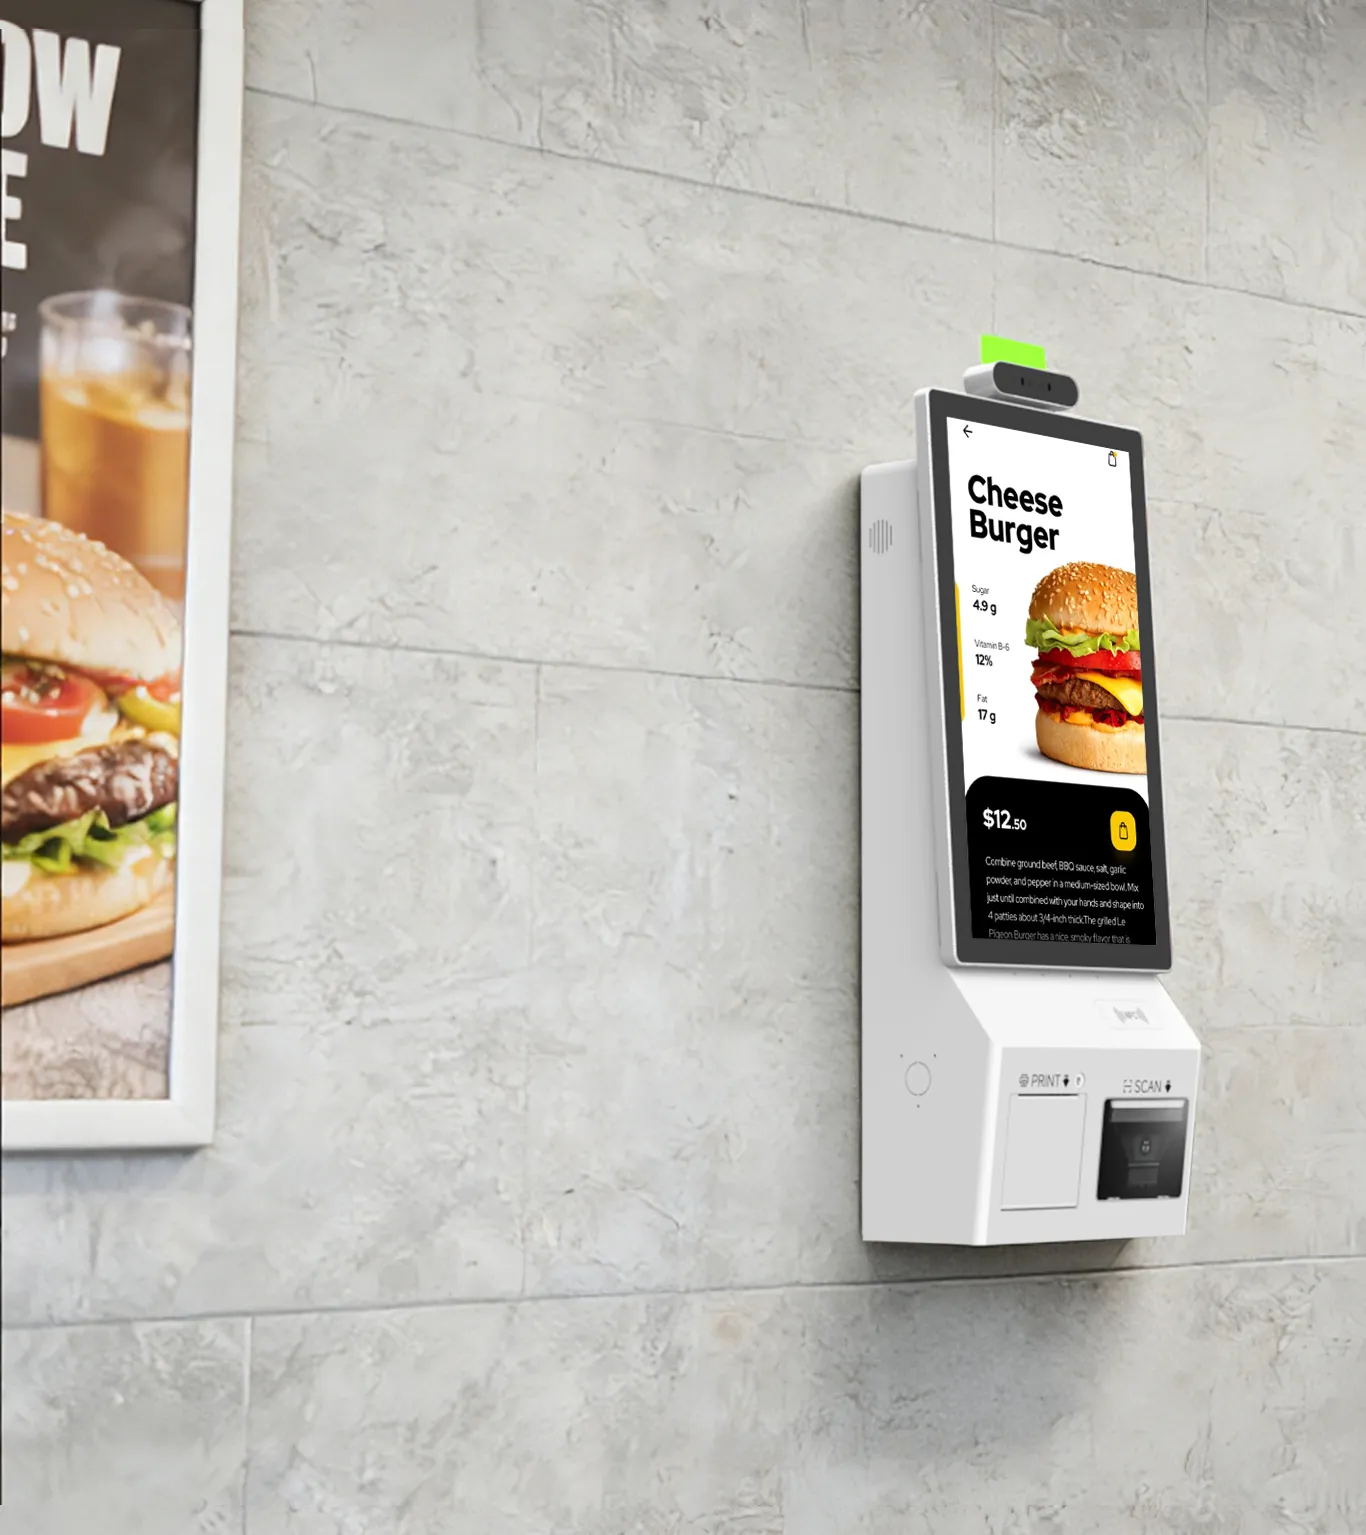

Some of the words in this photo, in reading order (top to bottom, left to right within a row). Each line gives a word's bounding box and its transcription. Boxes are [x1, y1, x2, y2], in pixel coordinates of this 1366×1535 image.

[968, 474, 1064, 518] Cheese
[969, 508, 1060, 555] Burger
[971, 584, 990, 596] Sugar
[972, 599, 989, 612] 4.9
[990, 603, 997, 616] g
[974, 638, 998, 650] Vitamin
[975, 653, 993, 667] 12%
[976, 693, 988, 704] Fat
[977, 708, 988, 721] 17
[989, 712, 997, 725] g
[983, 807, 1027, 830] $12.50
[985, 856, 1016, 867] Combine
[1016, 860, 1041, 871] ground
[1059, 861, 1075, 871] BBQ
[1109, 865, 1127, 876] garlic
[1013, 876, 1027, 886] and
[1027, 879, 1052, 889] pepper
[1058, 880, 1064, 888] a
[1064, 880, 1110, 891] medium-sized
[986, 892, 1000, 904] just
[1015, 894, 1049, 905] combined
[1063, 898, 1079, 908] your
[1078, 896, 1099, 908] hands
[1098, 899, 1112, 909] and
[1112, 900, 1132, 911] shape
[1131, 900, 1145, 910] into
[987, 910, 994, 920] 4
[994, 911, 1018, 922] patties
[1018, 912, 1039, 922] about
[1030, 1073, 1061, 1088] PRINT
[1134, 1079, 1162, 1094] SCAN
